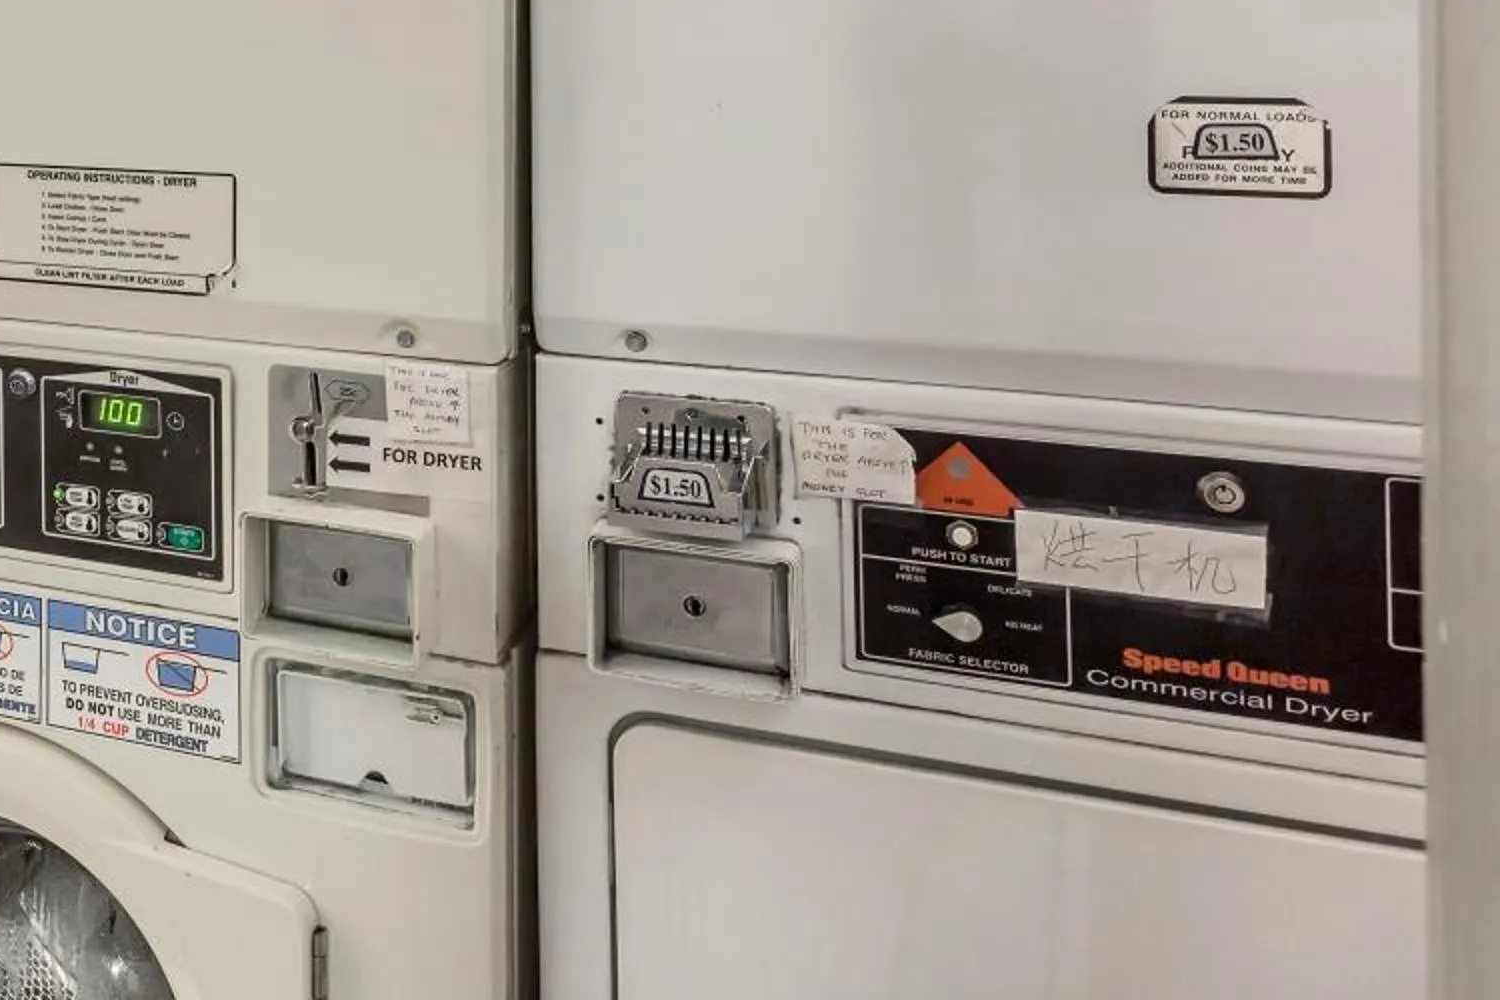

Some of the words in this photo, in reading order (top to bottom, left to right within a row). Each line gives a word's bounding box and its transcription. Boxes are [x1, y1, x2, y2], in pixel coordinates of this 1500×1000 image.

[1161, 110, 1190, 119] FOR
[1196, 111, 1260, 121] NORMAL
[1205, 132, 1264, 154] $1.50
[27, 169, 81, 183] OPERATING
[83, 172, 155, 186] INSTRUCTIONS
[163, 175, 197, 188] DRYER
[1163, 162, 1228, 172] ADDITIONAL
[1233, 164, 1268, 173] COINS
[1273, 165, 1297, 174] MAY
[1303, 166, 1317, 175] BE
[1172, 173, 1209, 181] ADDED
[1214, 174, 1237, 183] FOR
[1242, 175, 1275, 184] MORE
[1281, 176, 1307, 185] TIME
[137, 274, 159, 285] EACH
[161, 276, 185, 287] LOAD
[109, 371, 139, 388] Dryer
[99, 398, 142, 425] 100
[383, 447, 417, 464] FOR
[423, 452, 483, 471] DRYER
[650, 476, 700, 499] $1.50
[912, 547, 947, 560] PUSH
[950, 552, 967, 563] TO
[969, 554, 1012, 568] START
[85, 610, 196, 649] NOTICE
[908, 648, 955, 665] FABRIC
[958, 654, 1029, 675] SELECTOR
[1123, 647, 1221, 680] Speed
[1227, 661, 1331, 695] Queen
[11, 669, 26, 682] DE
[8, 685, 23, 697] DE
[62, 680, 77, 693] TO
[80, 684, 133, 705] PREVENT
[1086, 669, 1274, 712] Commercial
[1285, 697, 1373, 726] Dryer
[66, 698, 84, 710] DO
[88, 701, 115, 716] NOT
[117, 707, 141, 723] USE
[147, 712, 182, 730] MORE
[187, 722, 221, 739] THAN
[77, 717, 95, 730] 1/4
[102, 722, 129, 737] CUP
[135, 727, 209, 753] DETERGENT
